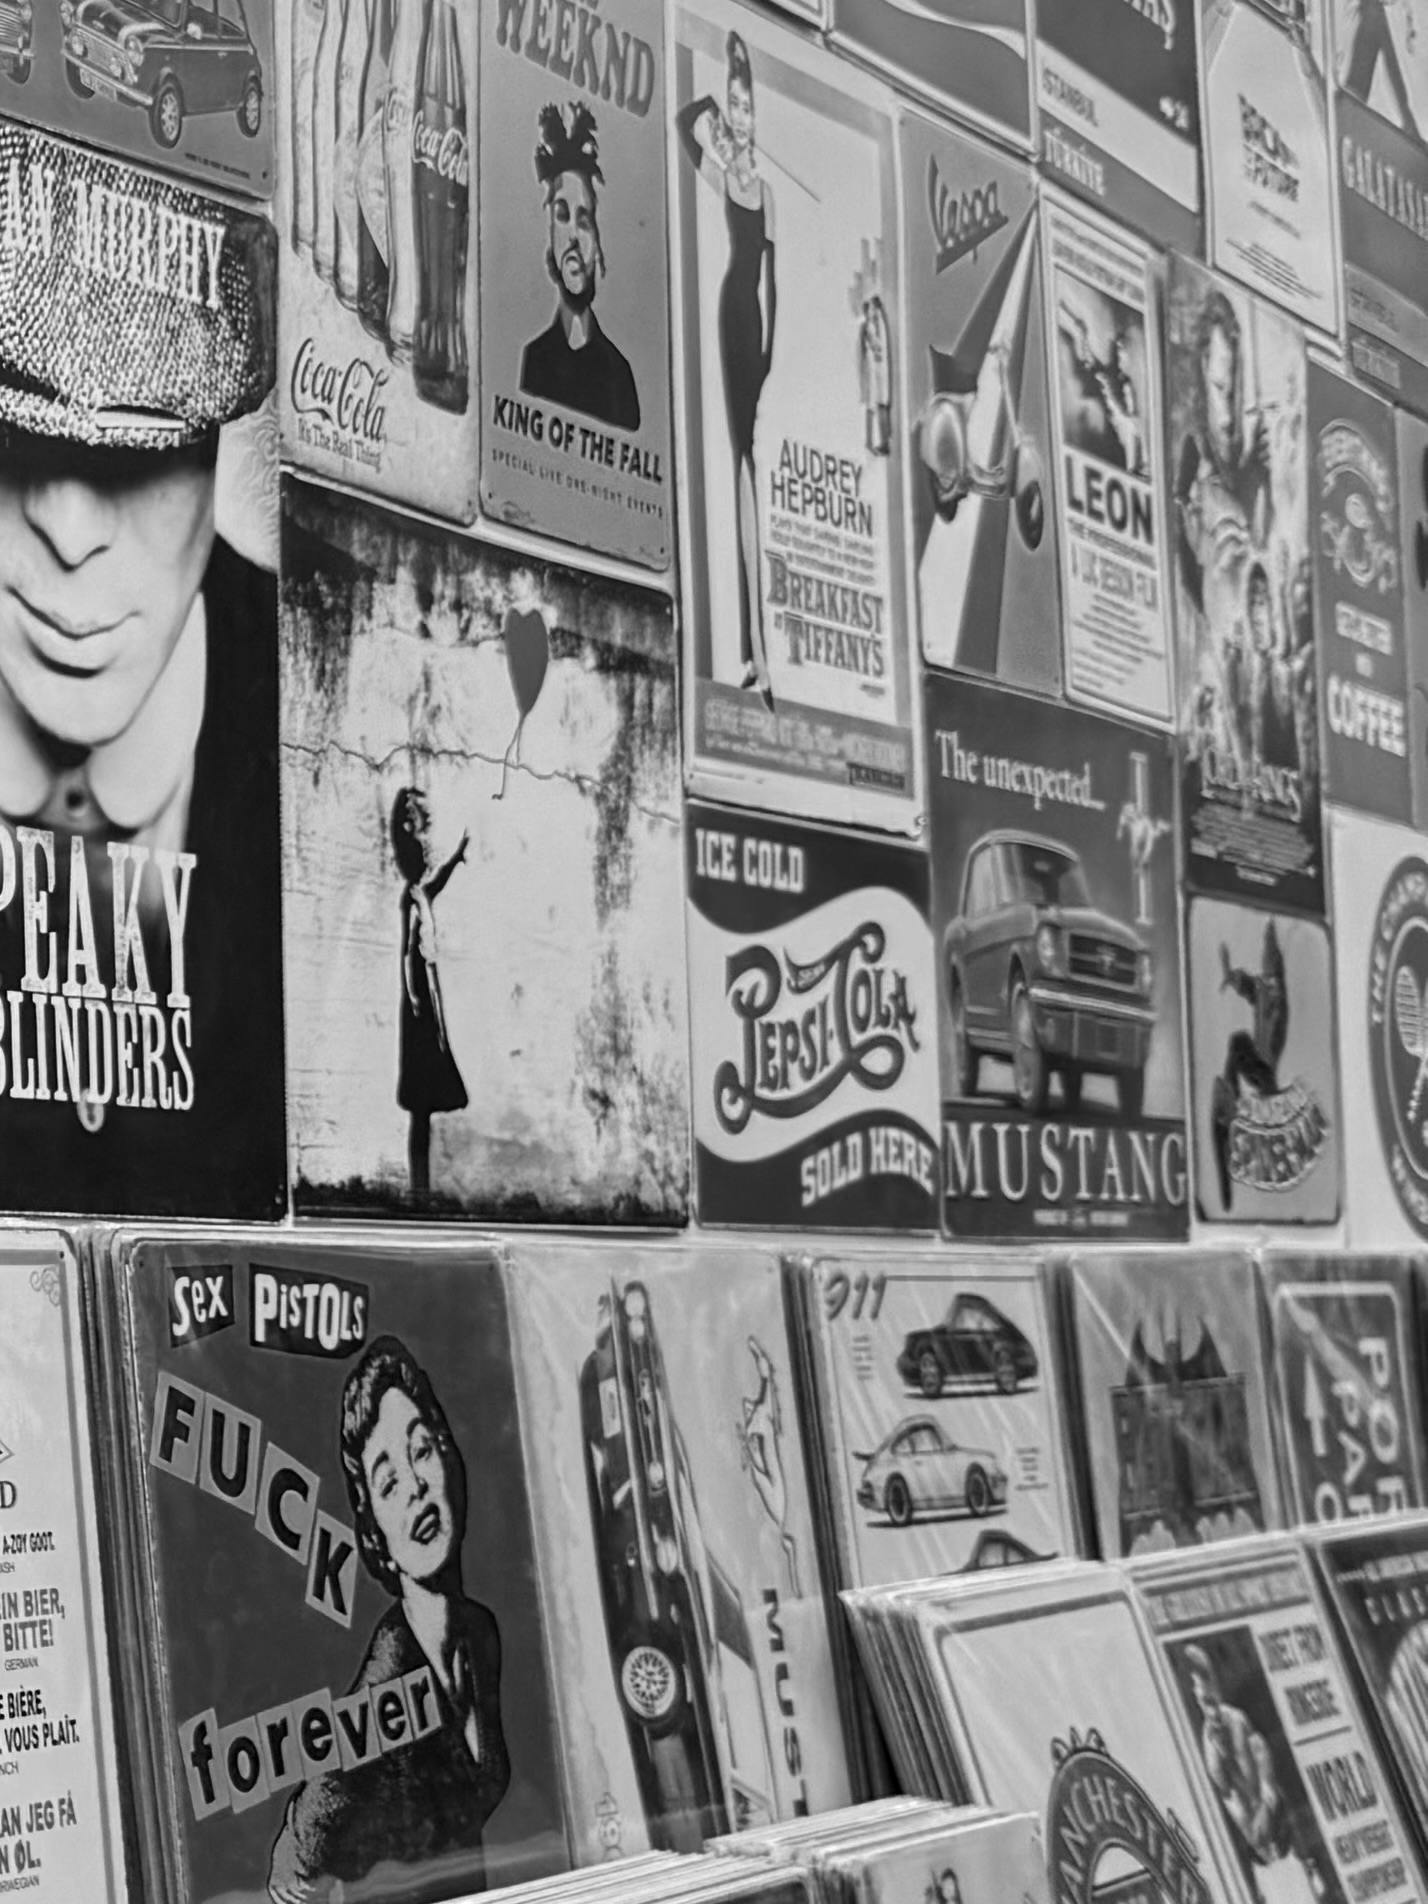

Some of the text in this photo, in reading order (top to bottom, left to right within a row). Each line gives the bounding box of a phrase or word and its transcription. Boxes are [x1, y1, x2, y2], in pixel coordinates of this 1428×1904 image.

[72, 180, 225, 309] MURPHY
[291, 336, 389, 441] Coca-Cola
[493, 395, 663, 484] KING OF THE FALL
[777, 438, 865, 501] AUDREY
[770, 467, 875, 537] HEPBURN
[1066, 454, 1153, 545] LEON
[764, 549, 883, 635] BREAKFAST
[935, 729, 978, 784] The
[1328, 672, 1406, 758] COFFEE
[696, 828, 805, 894] ICE COLD
[801, 1126, 934, 1207] SOLD HERE
[946, 1121, 1188, 1206] MUSTANG
[825, 1271, 887, 1322] 911
[159, 1384, 356, 1618] FUCK
[191, 1676, 432, 1805] forever
